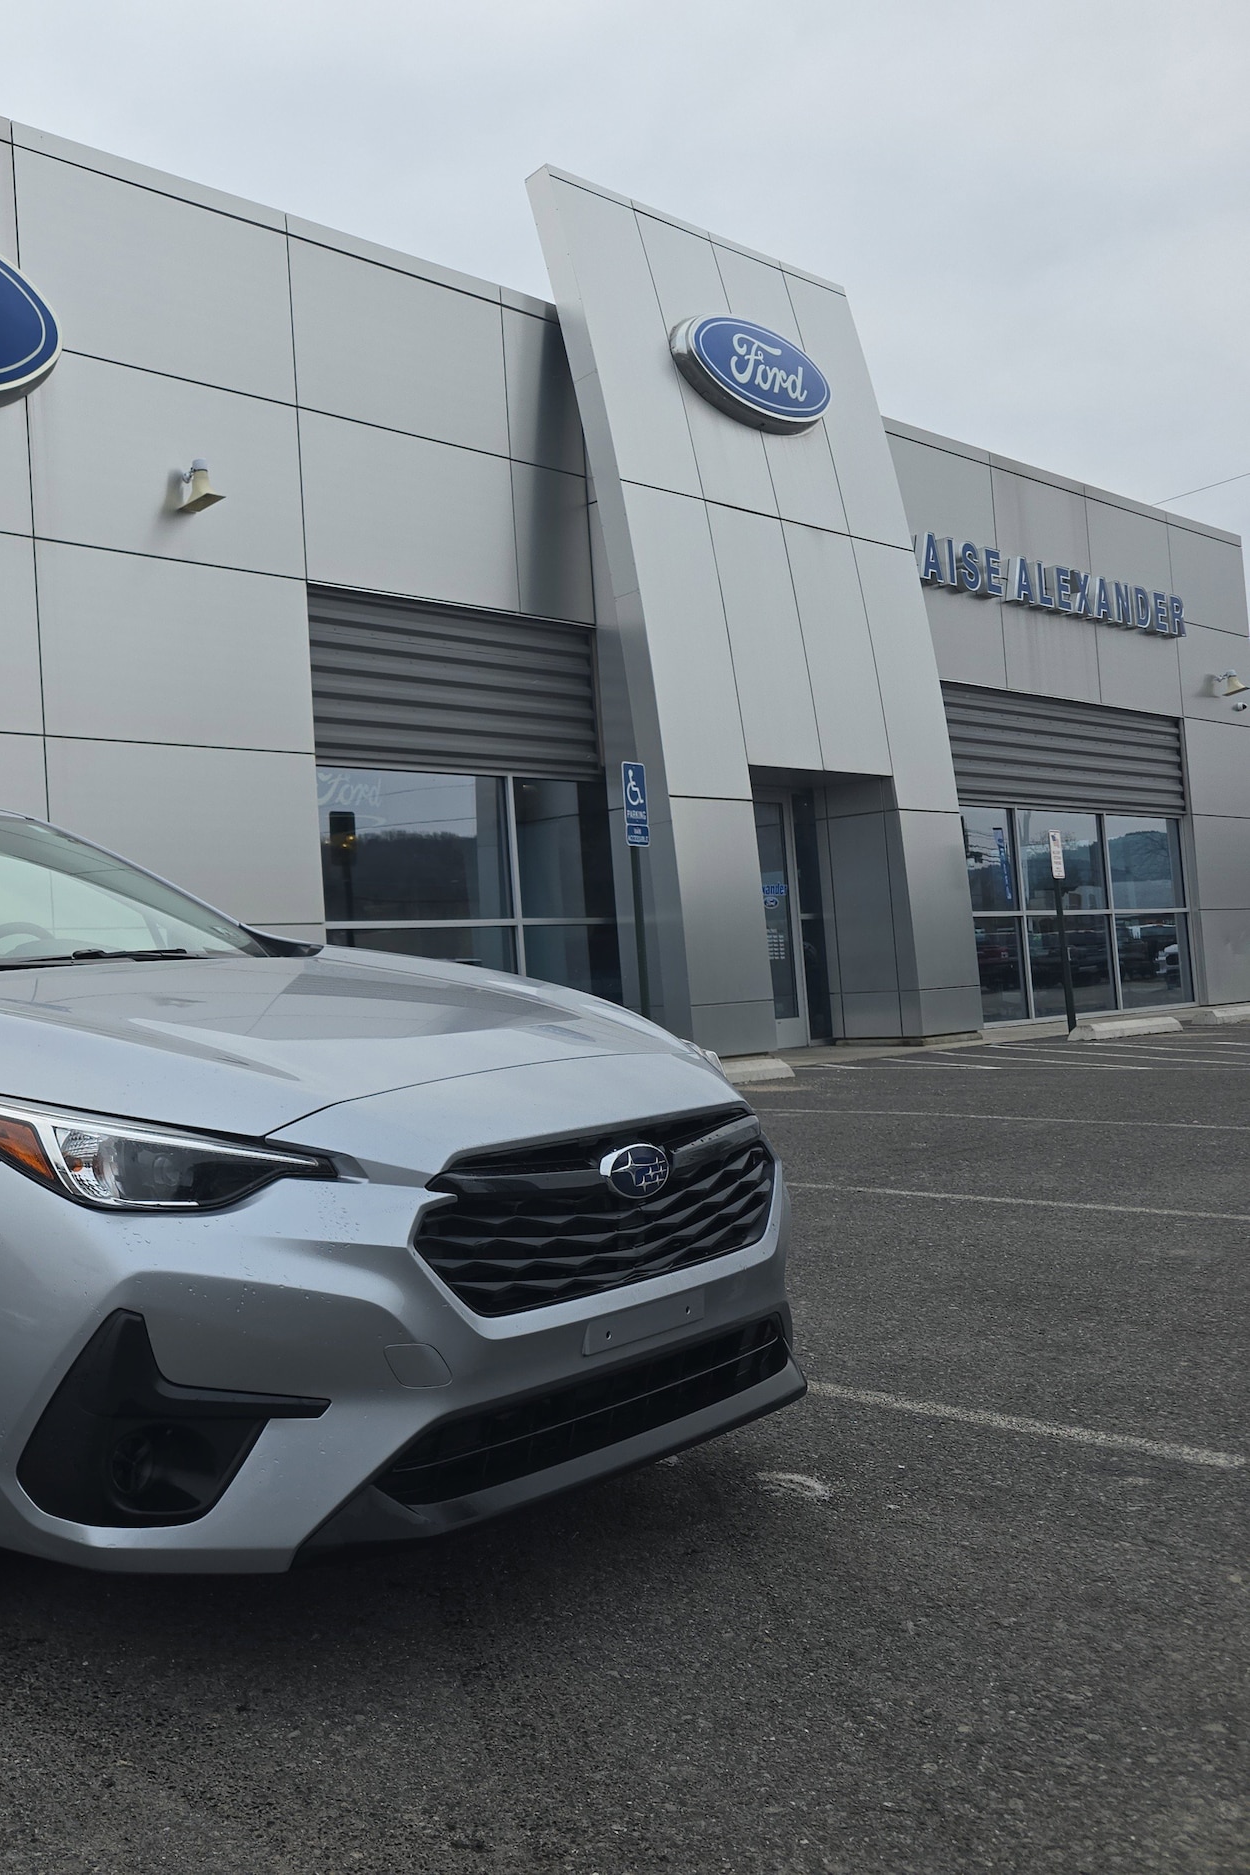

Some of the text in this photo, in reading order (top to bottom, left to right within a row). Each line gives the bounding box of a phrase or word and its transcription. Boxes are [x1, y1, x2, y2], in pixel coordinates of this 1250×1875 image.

[730, 333, 808, 403] Ford
[920, 531, 1187, 637] AISE ALEXANDER
